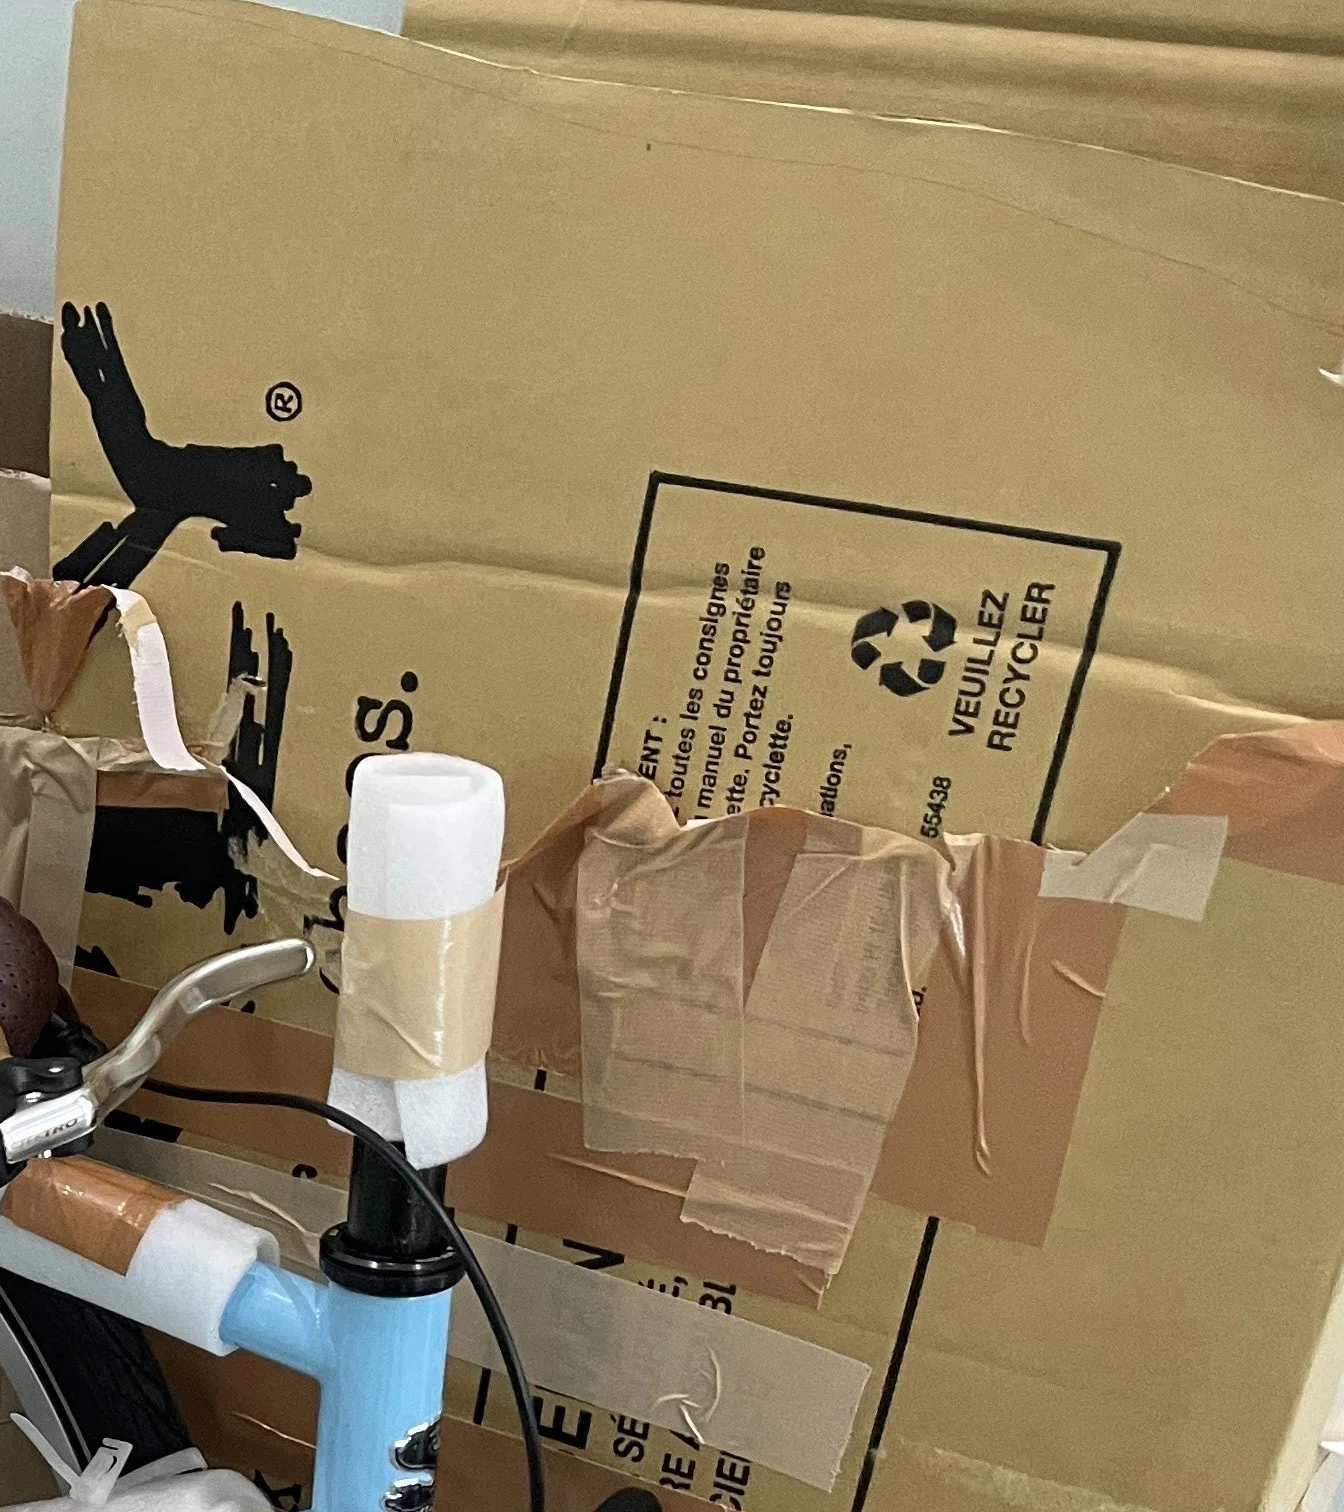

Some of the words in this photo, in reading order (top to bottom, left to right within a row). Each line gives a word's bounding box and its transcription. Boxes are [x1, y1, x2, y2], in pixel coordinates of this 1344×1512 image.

[692, 562, 730, 681] consignes
[723, 546, 766, 684] propriétaire
[947, 588, 1009, 737] VEUILLEZ
[679, 688, 704, 720] les
[713, 690, 735, 719] du
[733, 684, 768, 760] Portez
[752, 581, 792, 678] toujours
[986, 581, 1055, 752] RECYCLER
[664, 727, 696, 798] toutes
[696, 725, 728, 809] manuel
[920, 775, 952, 838] 55438
